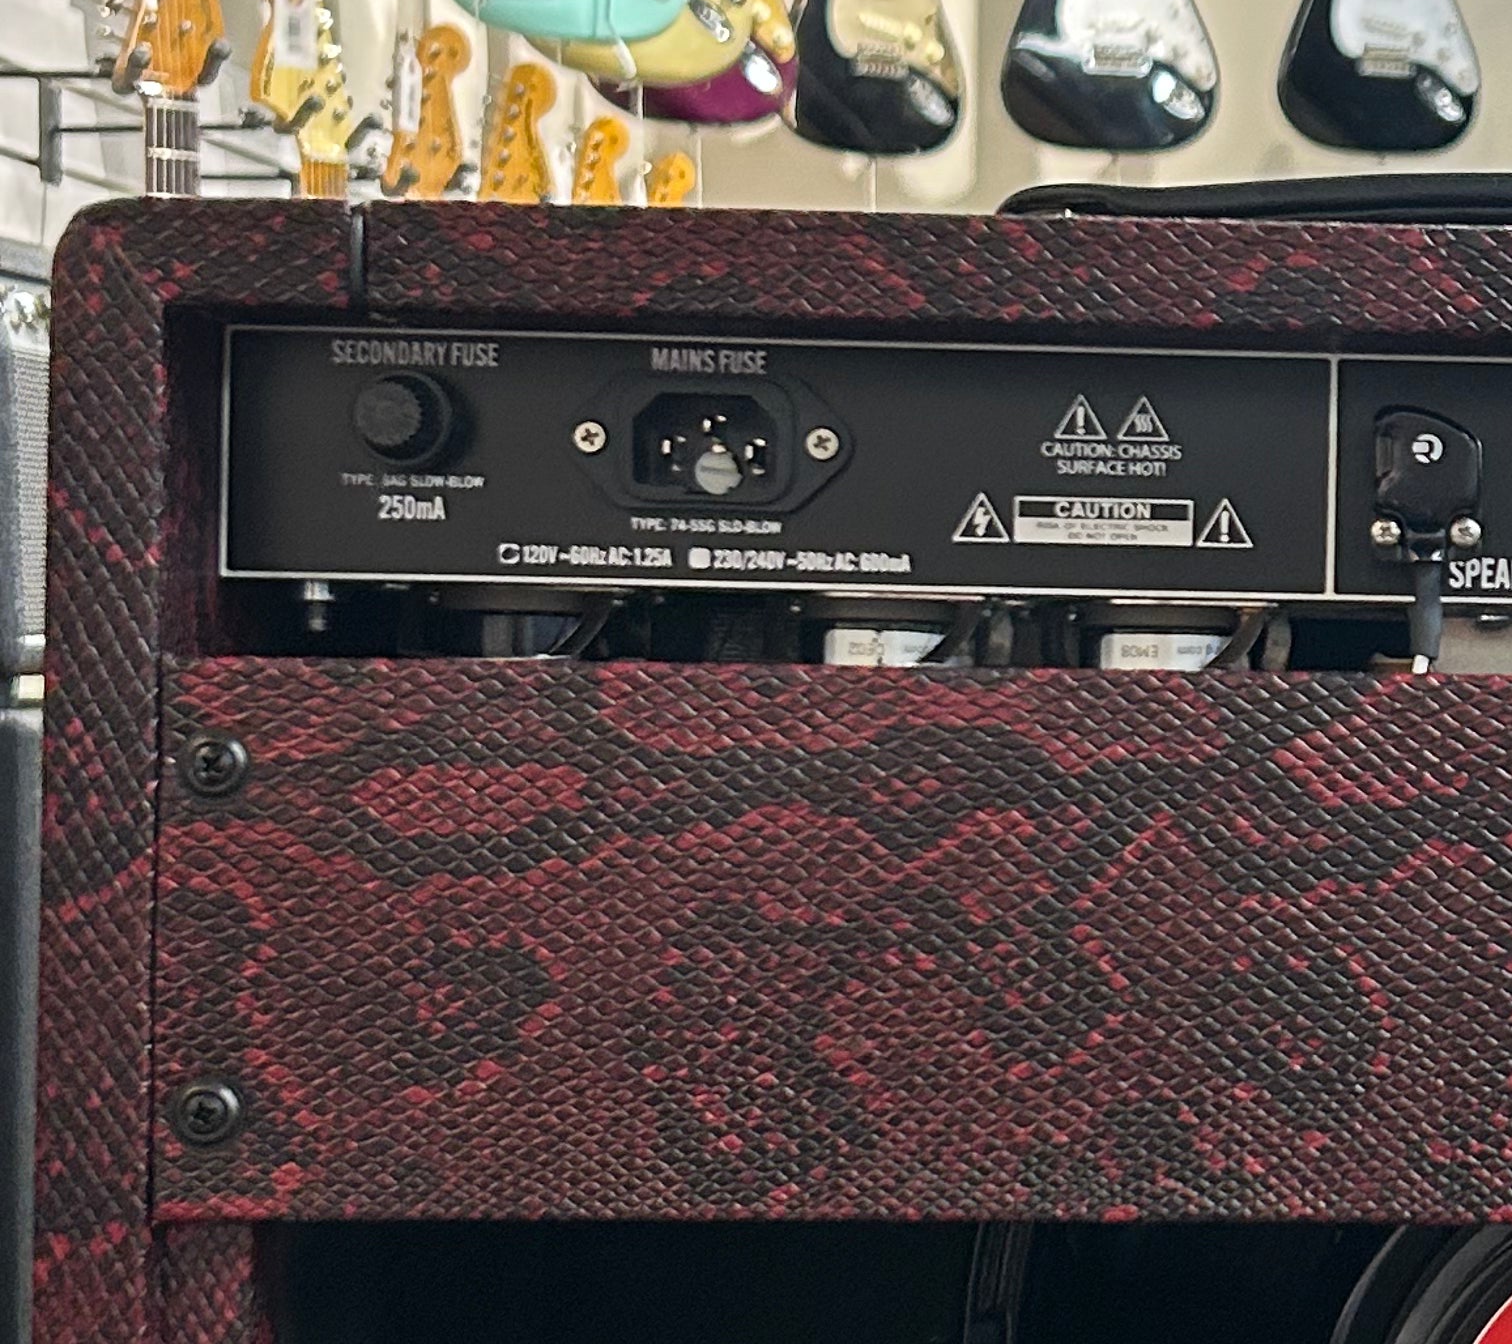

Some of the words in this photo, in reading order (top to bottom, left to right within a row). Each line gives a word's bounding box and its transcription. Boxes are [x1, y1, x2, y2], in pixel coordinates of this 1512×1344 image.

[332, 339, 447, 366] SECONDARY
[451, 342, 499, 367] FUSE
[650, 347, 715, 373] MAINS
[719, 350, 768, 376] FUSE
[1118, 443, 1182, 460] CHASSIS
[1056, 459, 1125, 476] SURFACE
[377, 494, 446, 520] 250mA
[1055, 501, 1151, 519] CAUTION
